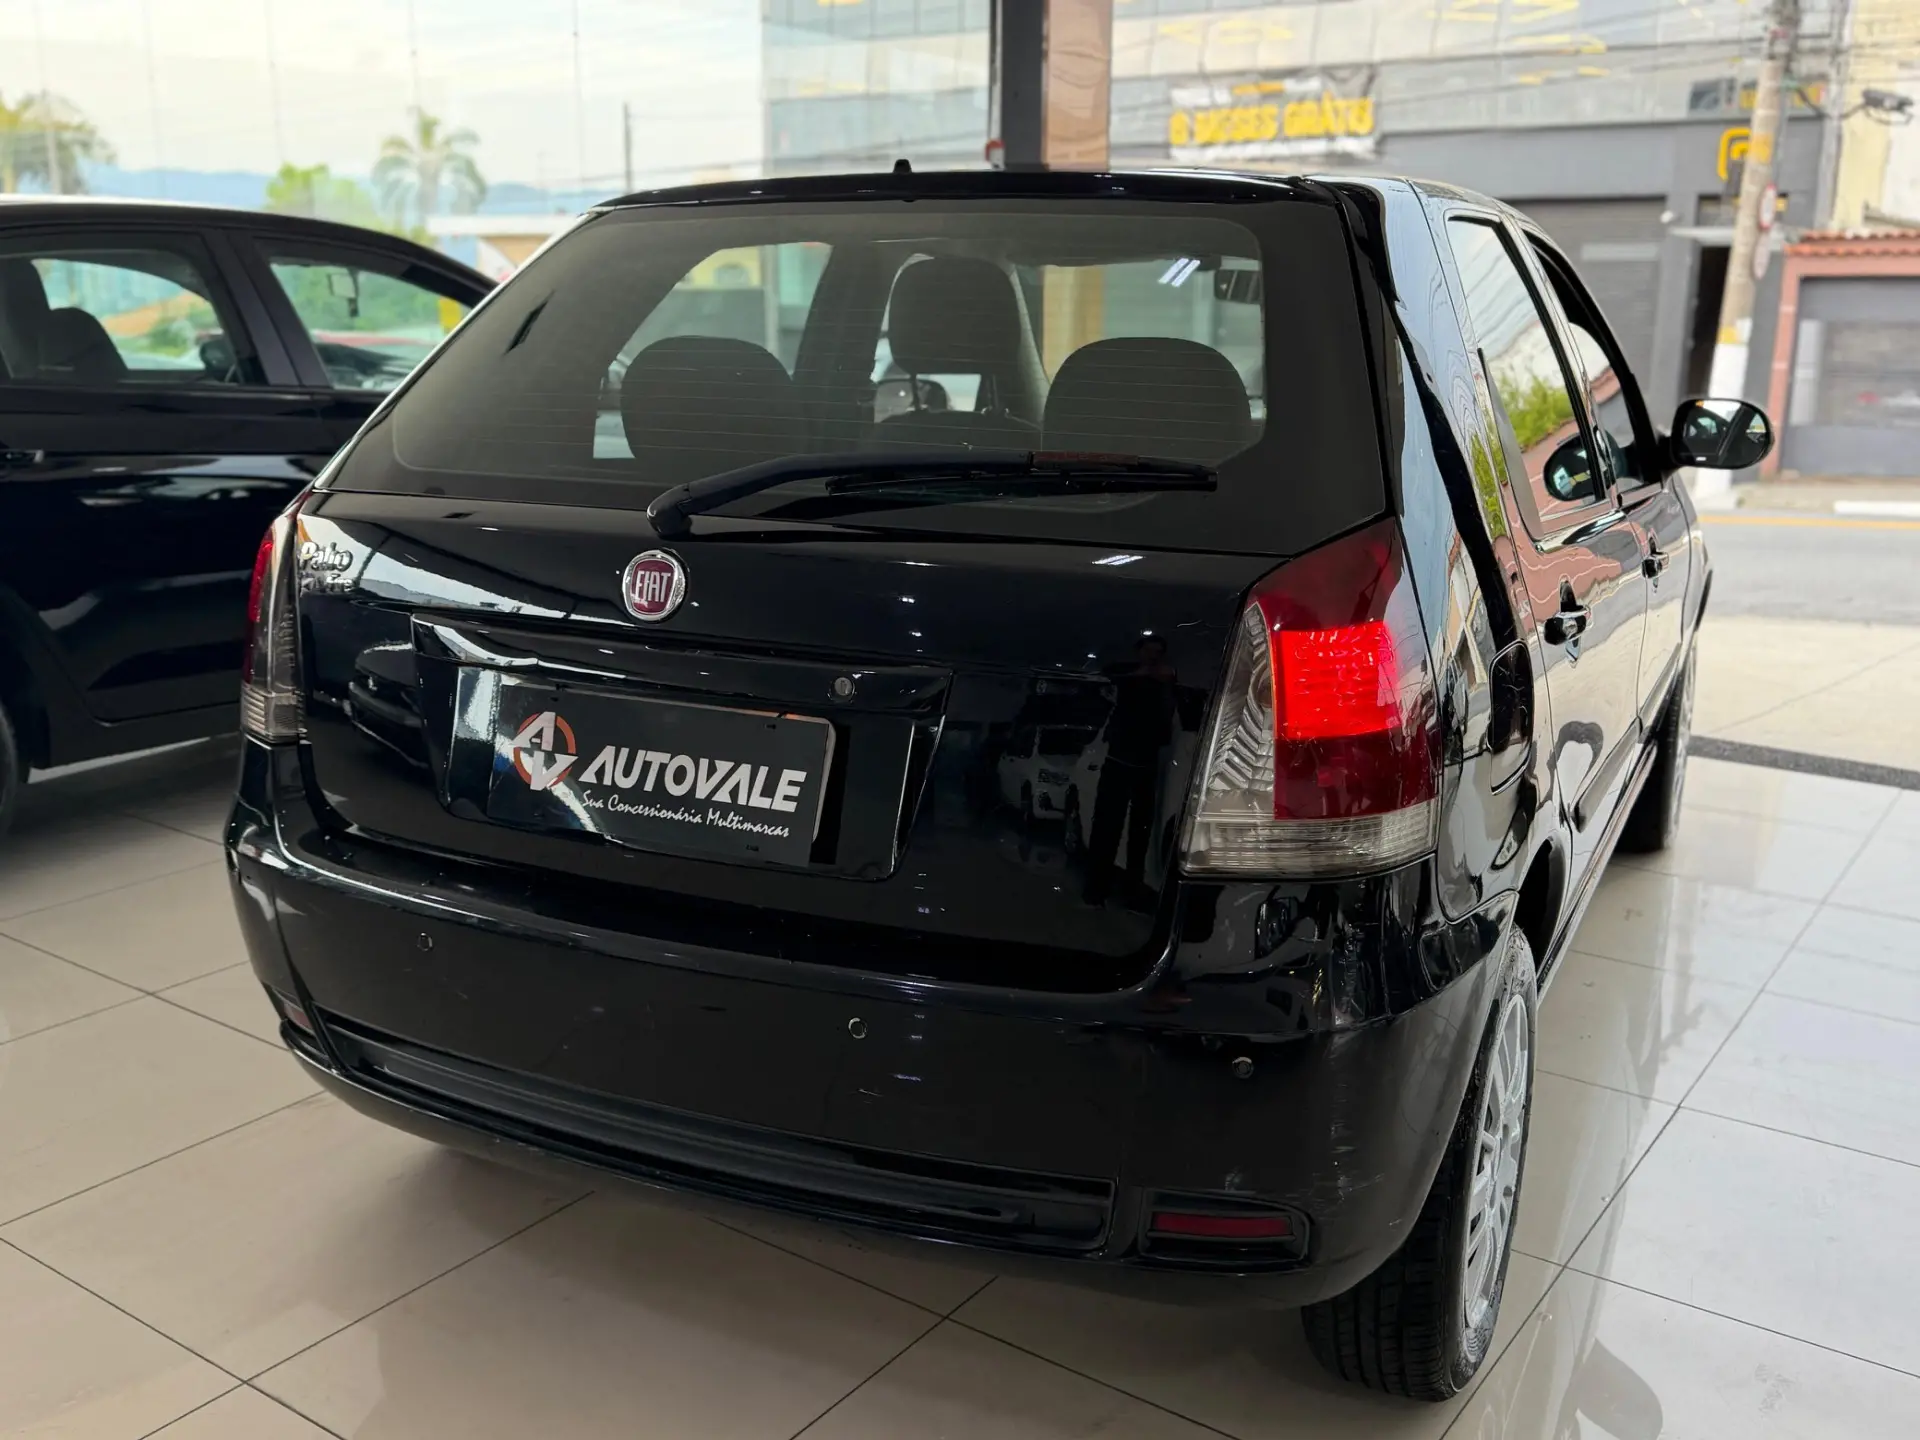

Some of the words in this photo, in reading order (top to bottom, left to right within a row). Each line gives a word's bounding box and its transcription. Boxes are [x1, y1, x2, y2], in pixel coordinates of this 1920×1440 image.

[299, 541, 353, 572] Palio
[635, 570, 671, 603] FIAT
[578, 745, 807, 813] AUTOVALE
[582, 790, 604, 809] Sua
[607, 794, 703, 823] Concessionária
[706, 807, 790, 837] Multimarcas
